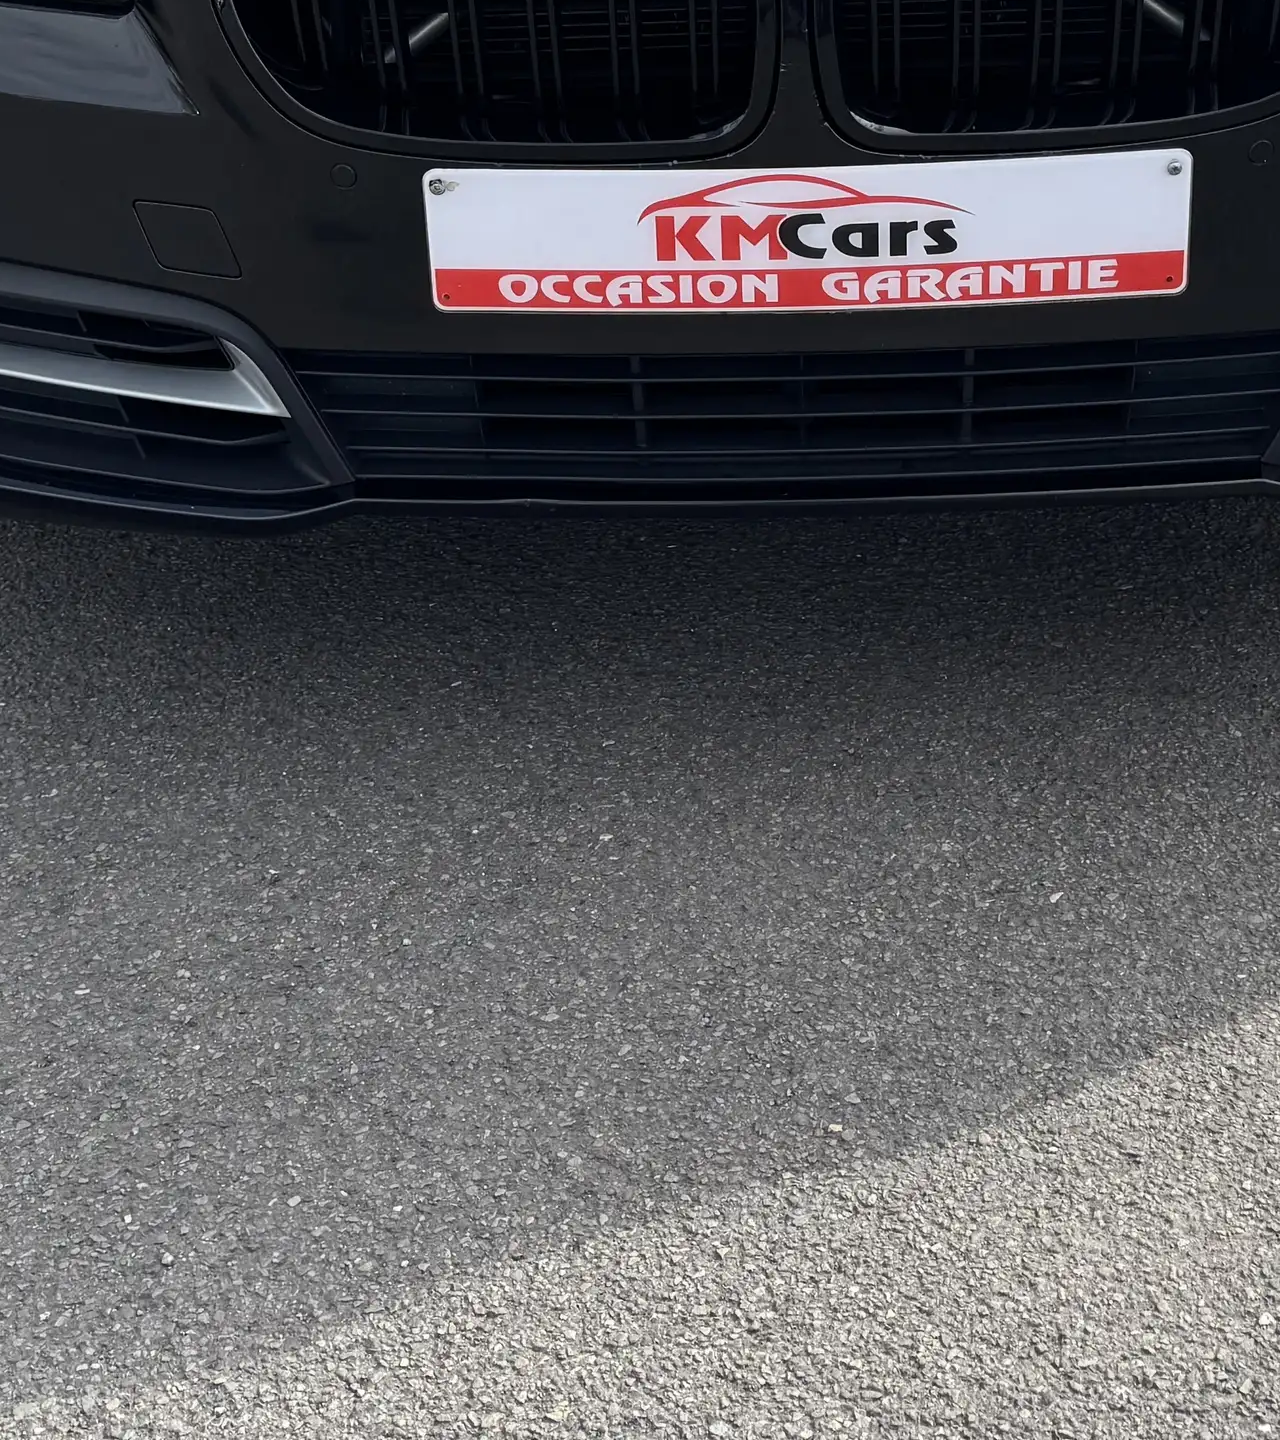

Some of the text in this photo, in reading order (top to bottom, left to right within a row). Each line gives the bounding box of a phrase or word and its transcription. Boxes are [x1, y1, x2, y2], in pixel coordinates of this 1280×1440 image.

[653, 210, 958, 262] KMCars
[498, 258, 1120, 308] OCCASION GARANTIE
